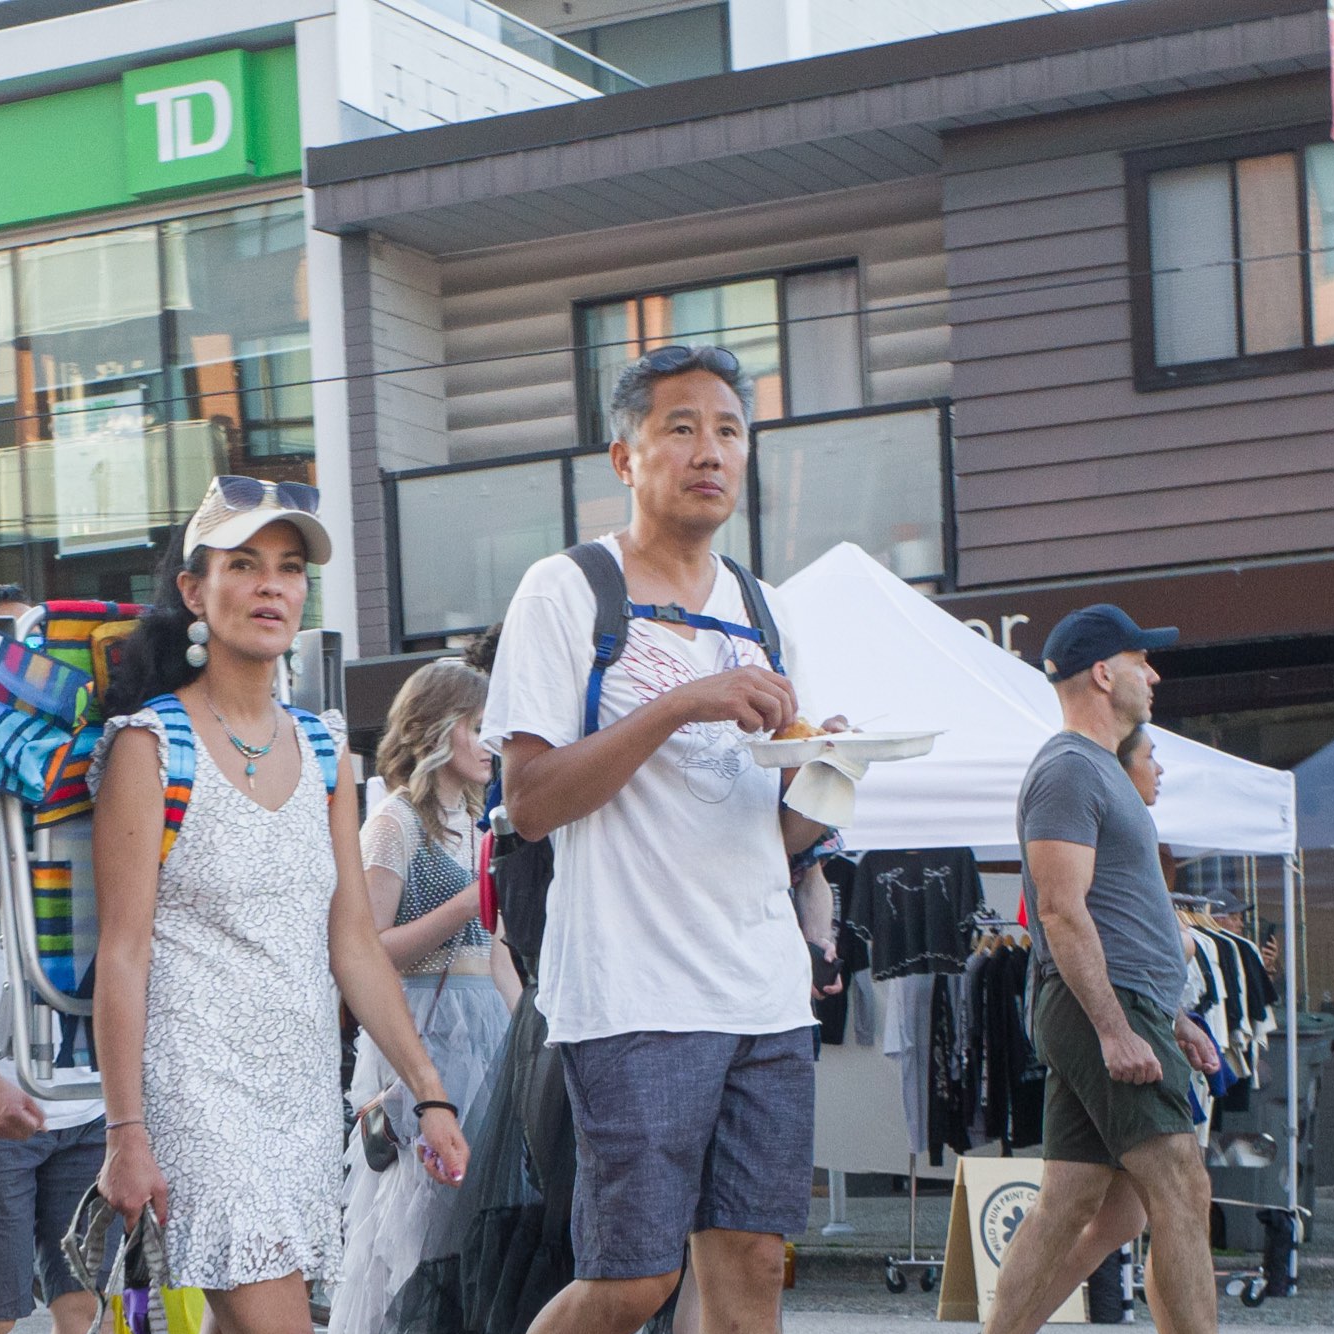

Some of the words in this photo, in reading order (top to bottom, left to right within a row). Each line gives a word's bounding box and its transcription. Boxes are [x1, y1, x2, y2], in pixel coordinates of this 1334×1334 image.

[135, 80, 232, 163] TD
[990, 1204, 1002, 1225] RUN
[1001, 1190, 1024, 1206] PRINT
